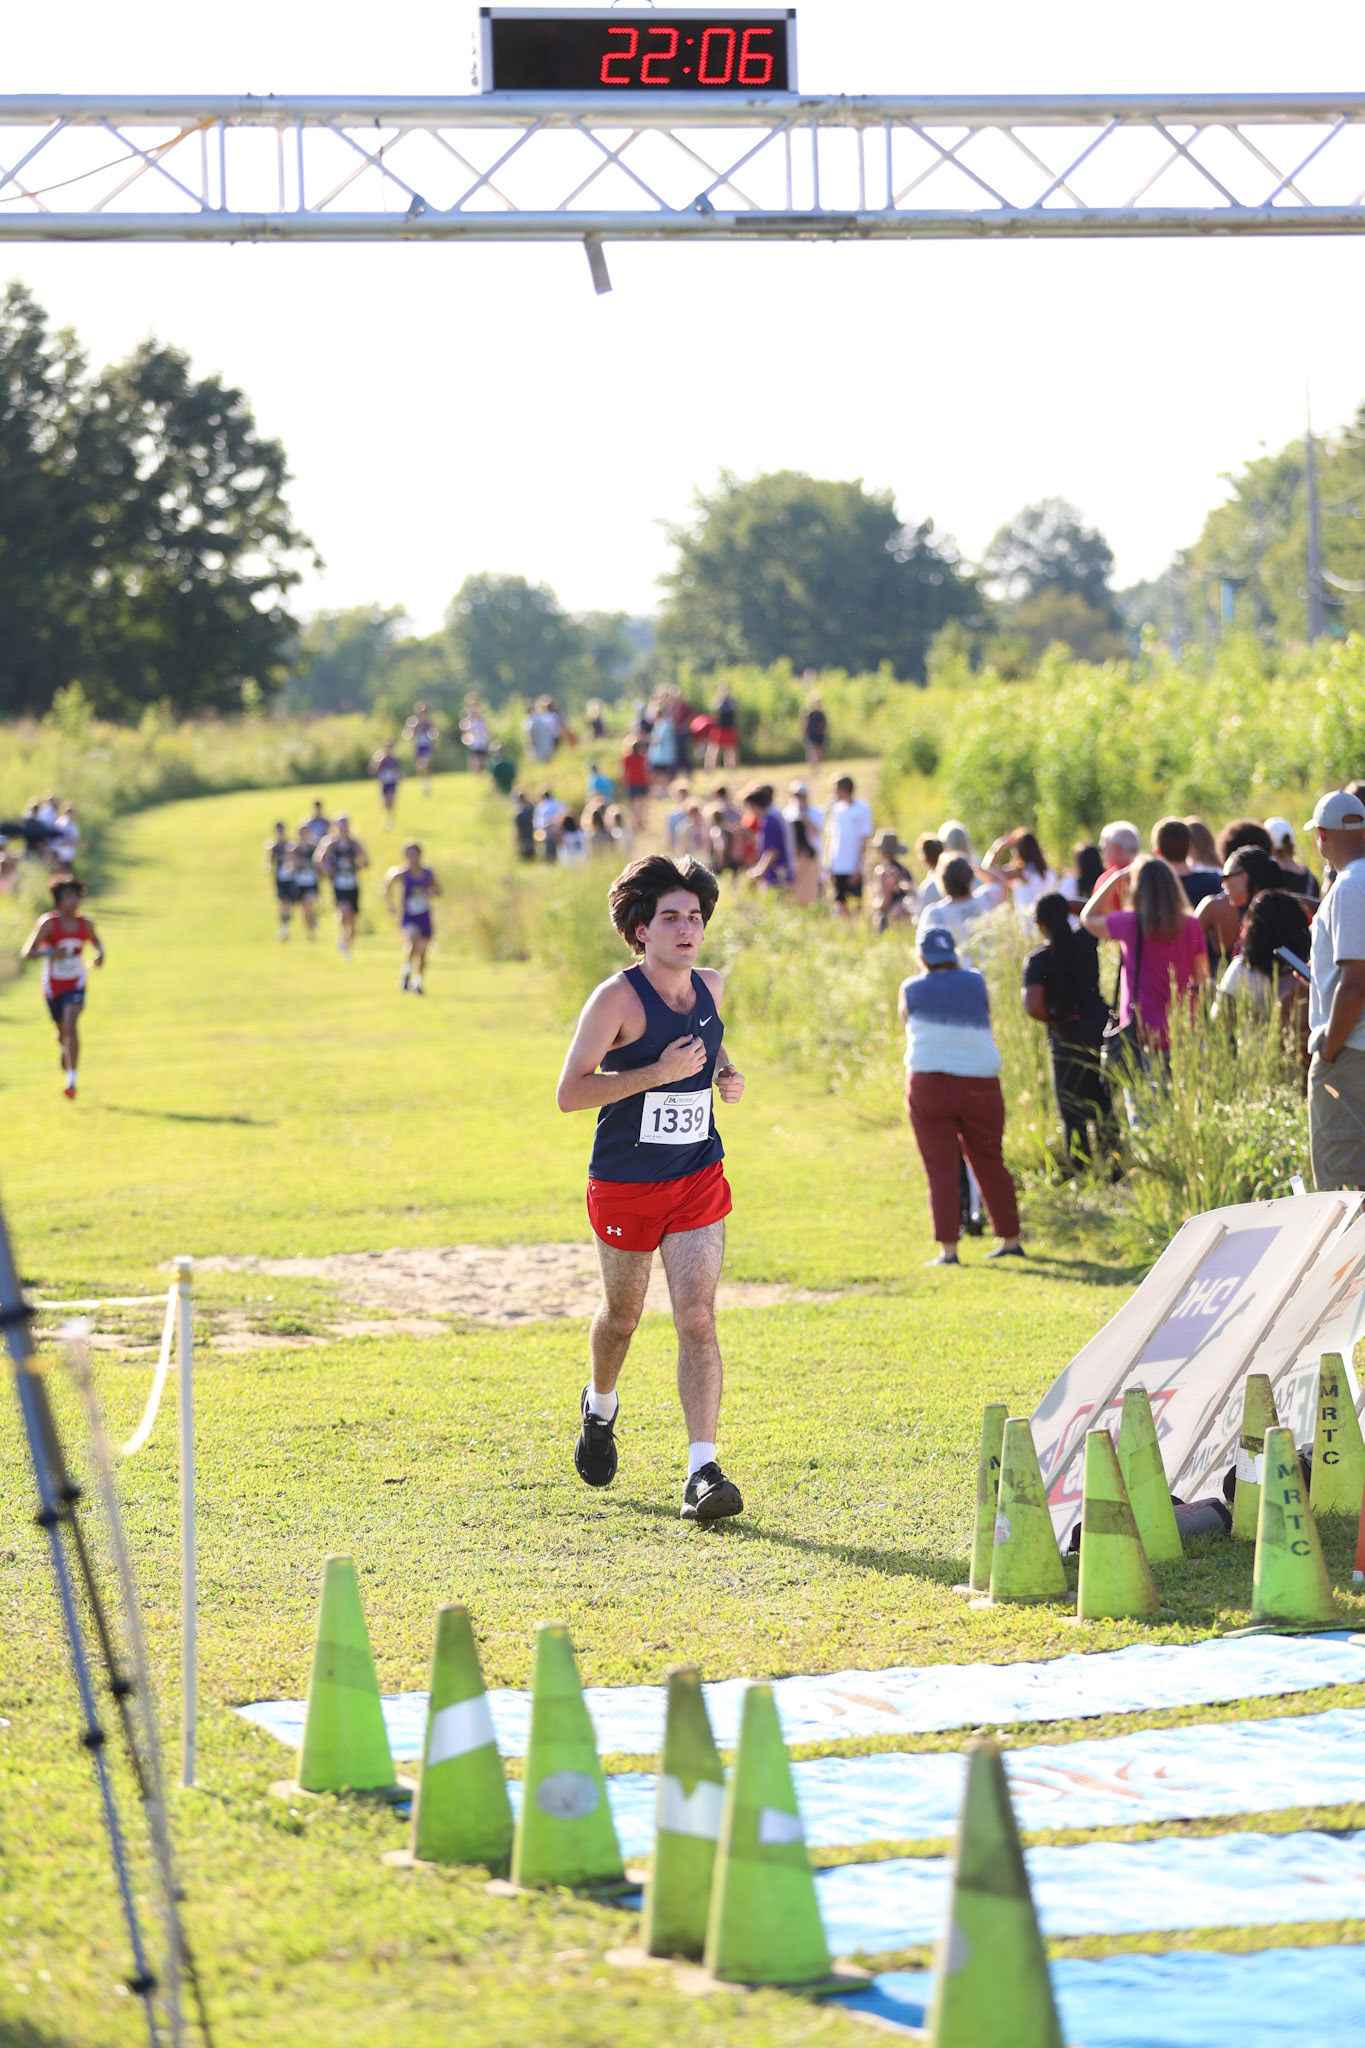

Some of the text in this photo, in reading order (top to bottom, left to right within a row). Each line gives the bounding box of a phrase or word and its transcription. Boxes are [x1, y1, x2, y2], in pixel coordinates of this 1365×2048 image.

[600, 27, 774, 84] 22:06
[652, 1106, 704, 1133] 1339
[1319, 1384, 1340, 1465] MRTC
[1277, 1463, 1311, 1556] MRTC
